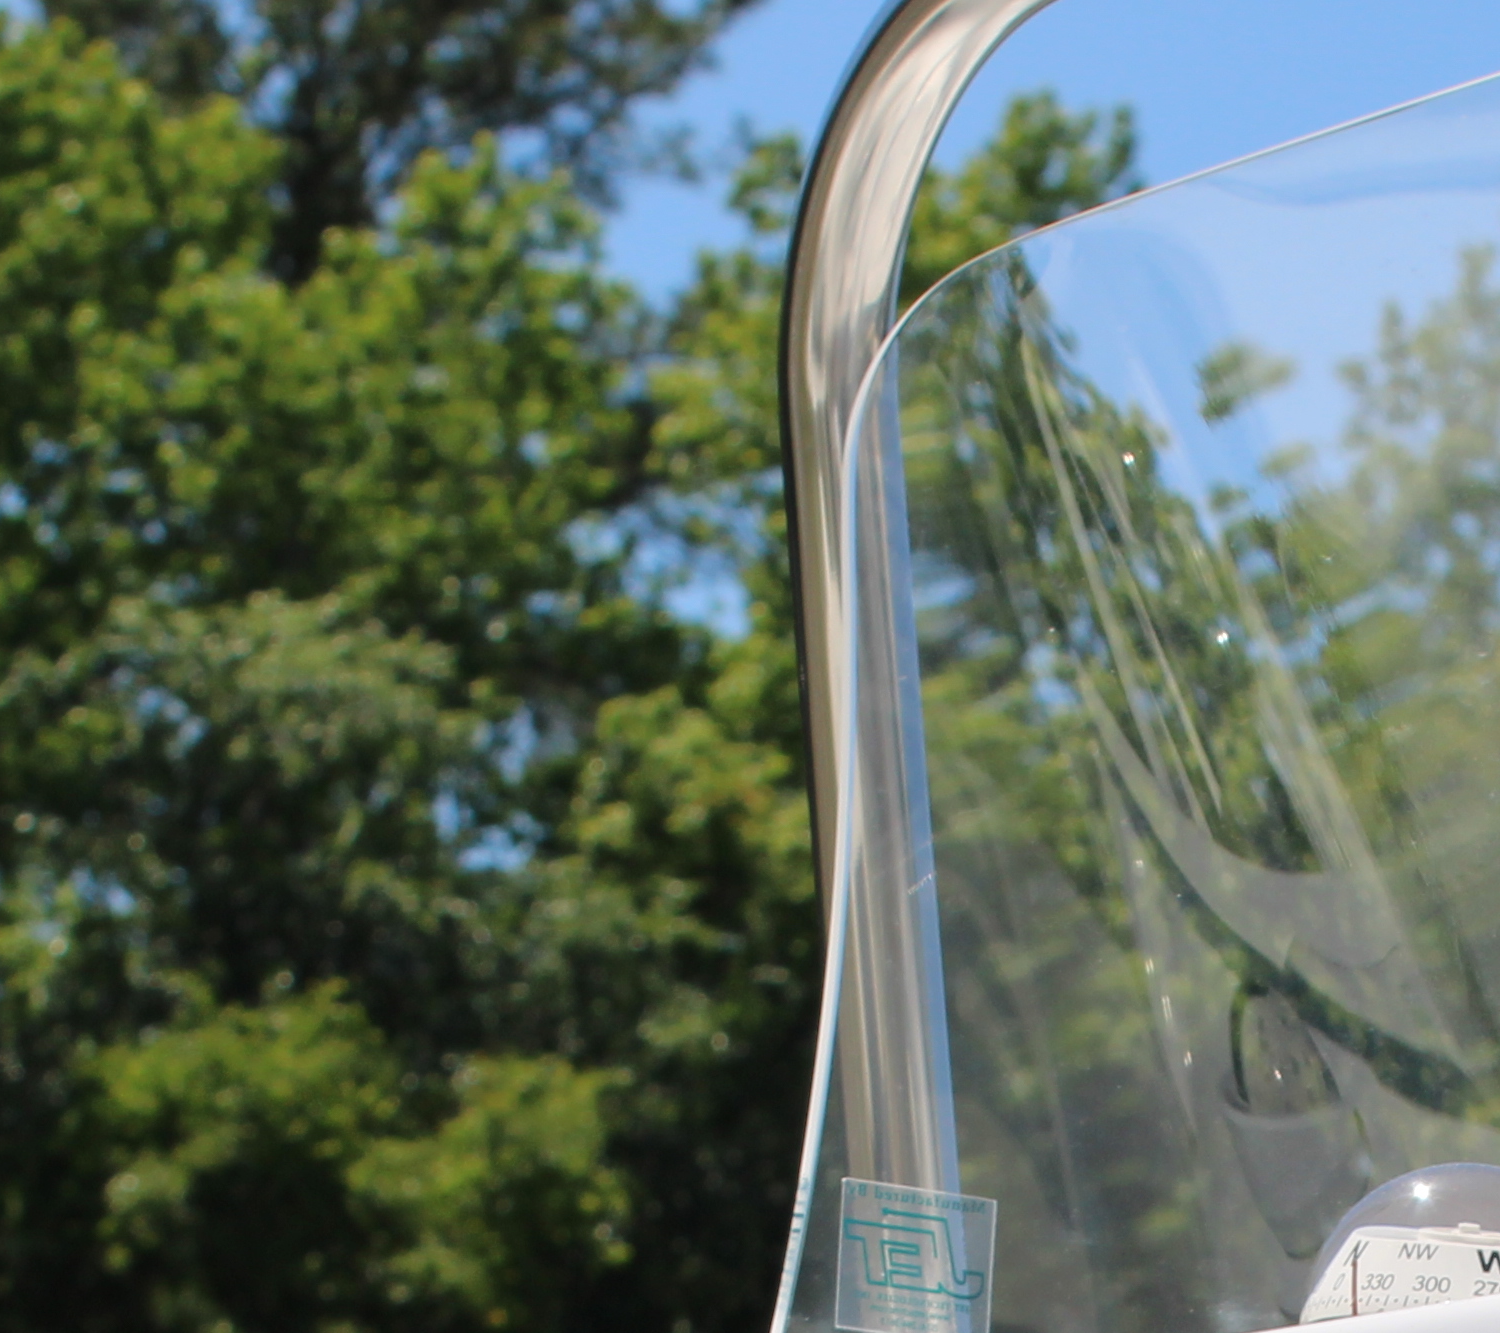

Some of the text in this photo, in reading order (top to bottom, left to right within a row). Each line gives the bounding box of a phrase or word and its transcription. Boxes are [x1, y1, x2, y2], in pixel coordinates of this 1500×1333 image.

[1344, 1241, 1369, 1268] N
[1398, 1243, 1439, 1261] NW
[1362, 1273, 1395, 1291] 330
[1412, 1275, 1451, 1293] 300
